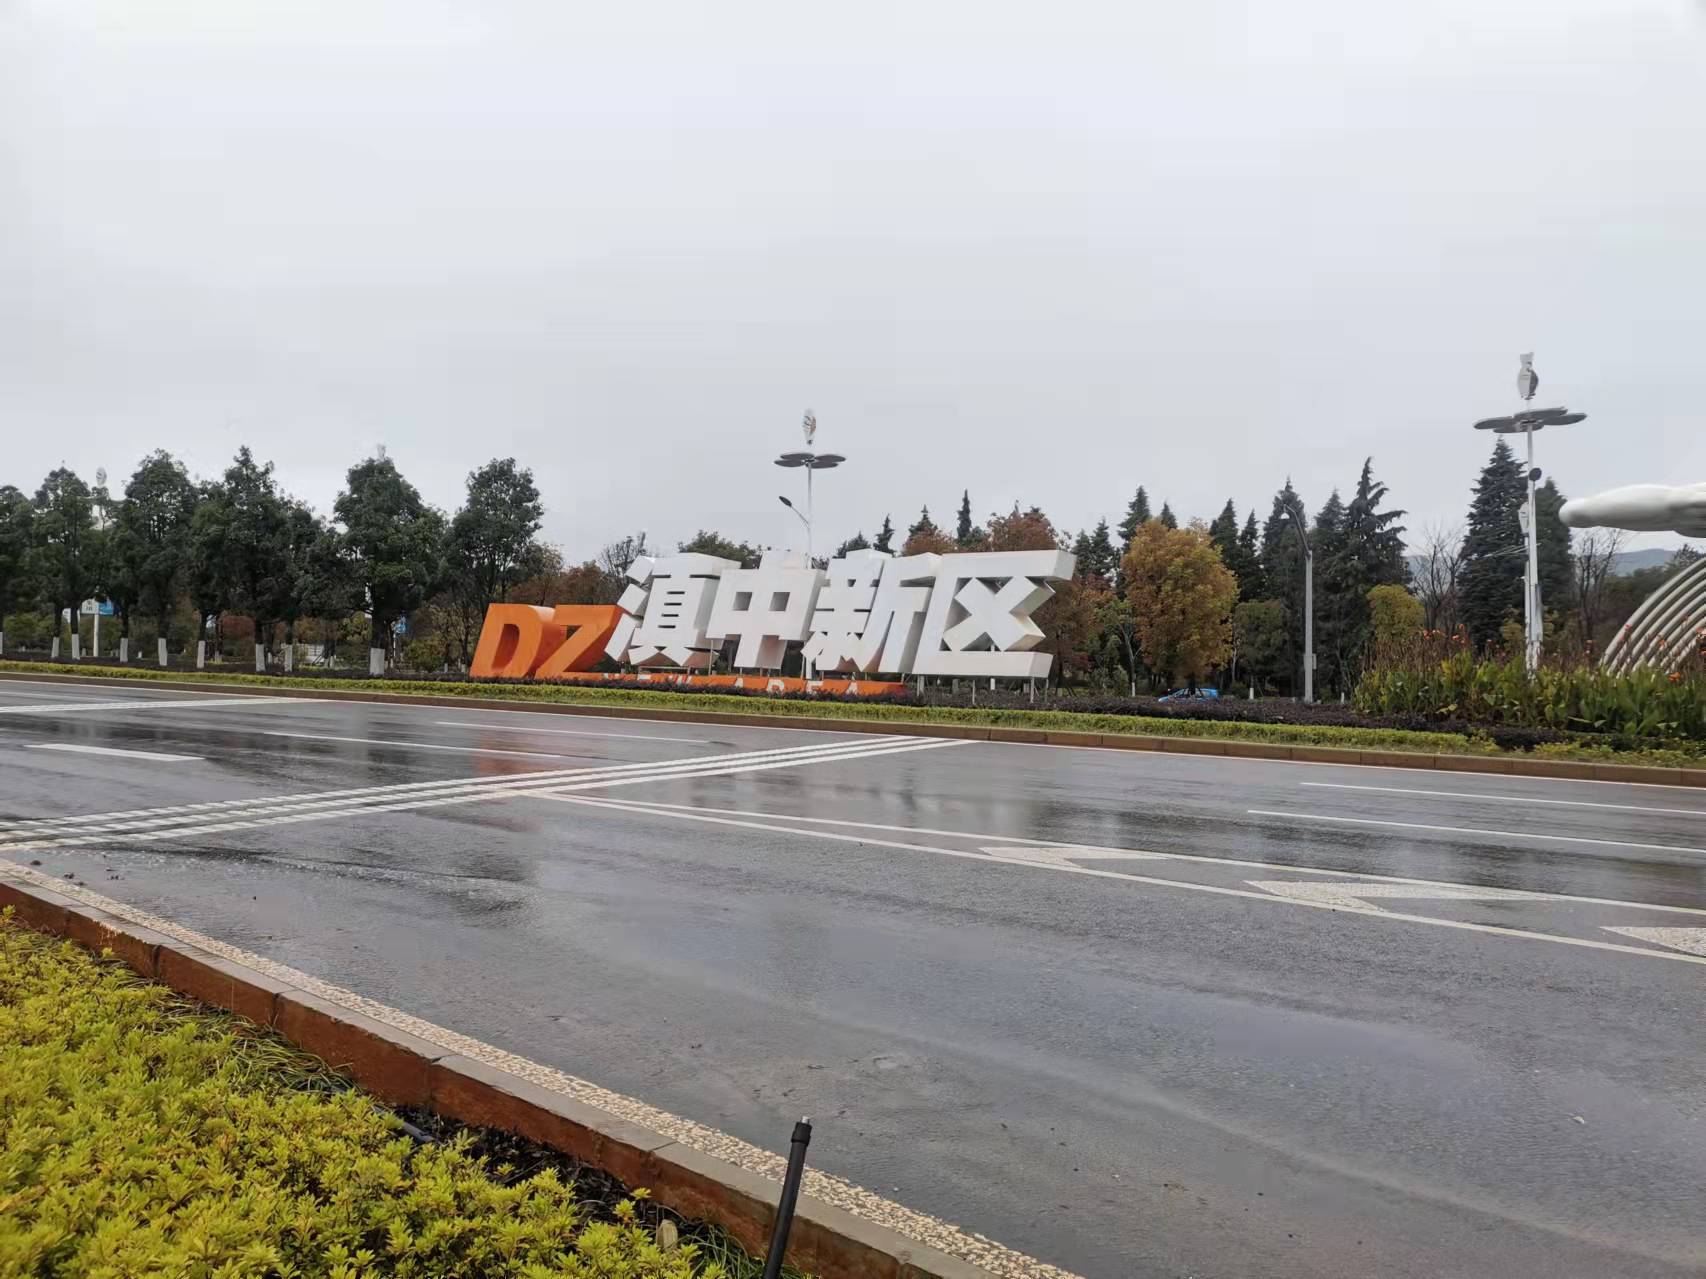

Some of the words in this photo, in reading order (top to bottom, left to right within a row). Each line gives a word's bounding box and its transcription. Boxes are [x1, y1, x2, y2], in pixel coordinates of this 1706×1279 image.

[470, 603, 622, 680] DZ
[604, 549, 1077, 678] 滇中新区
